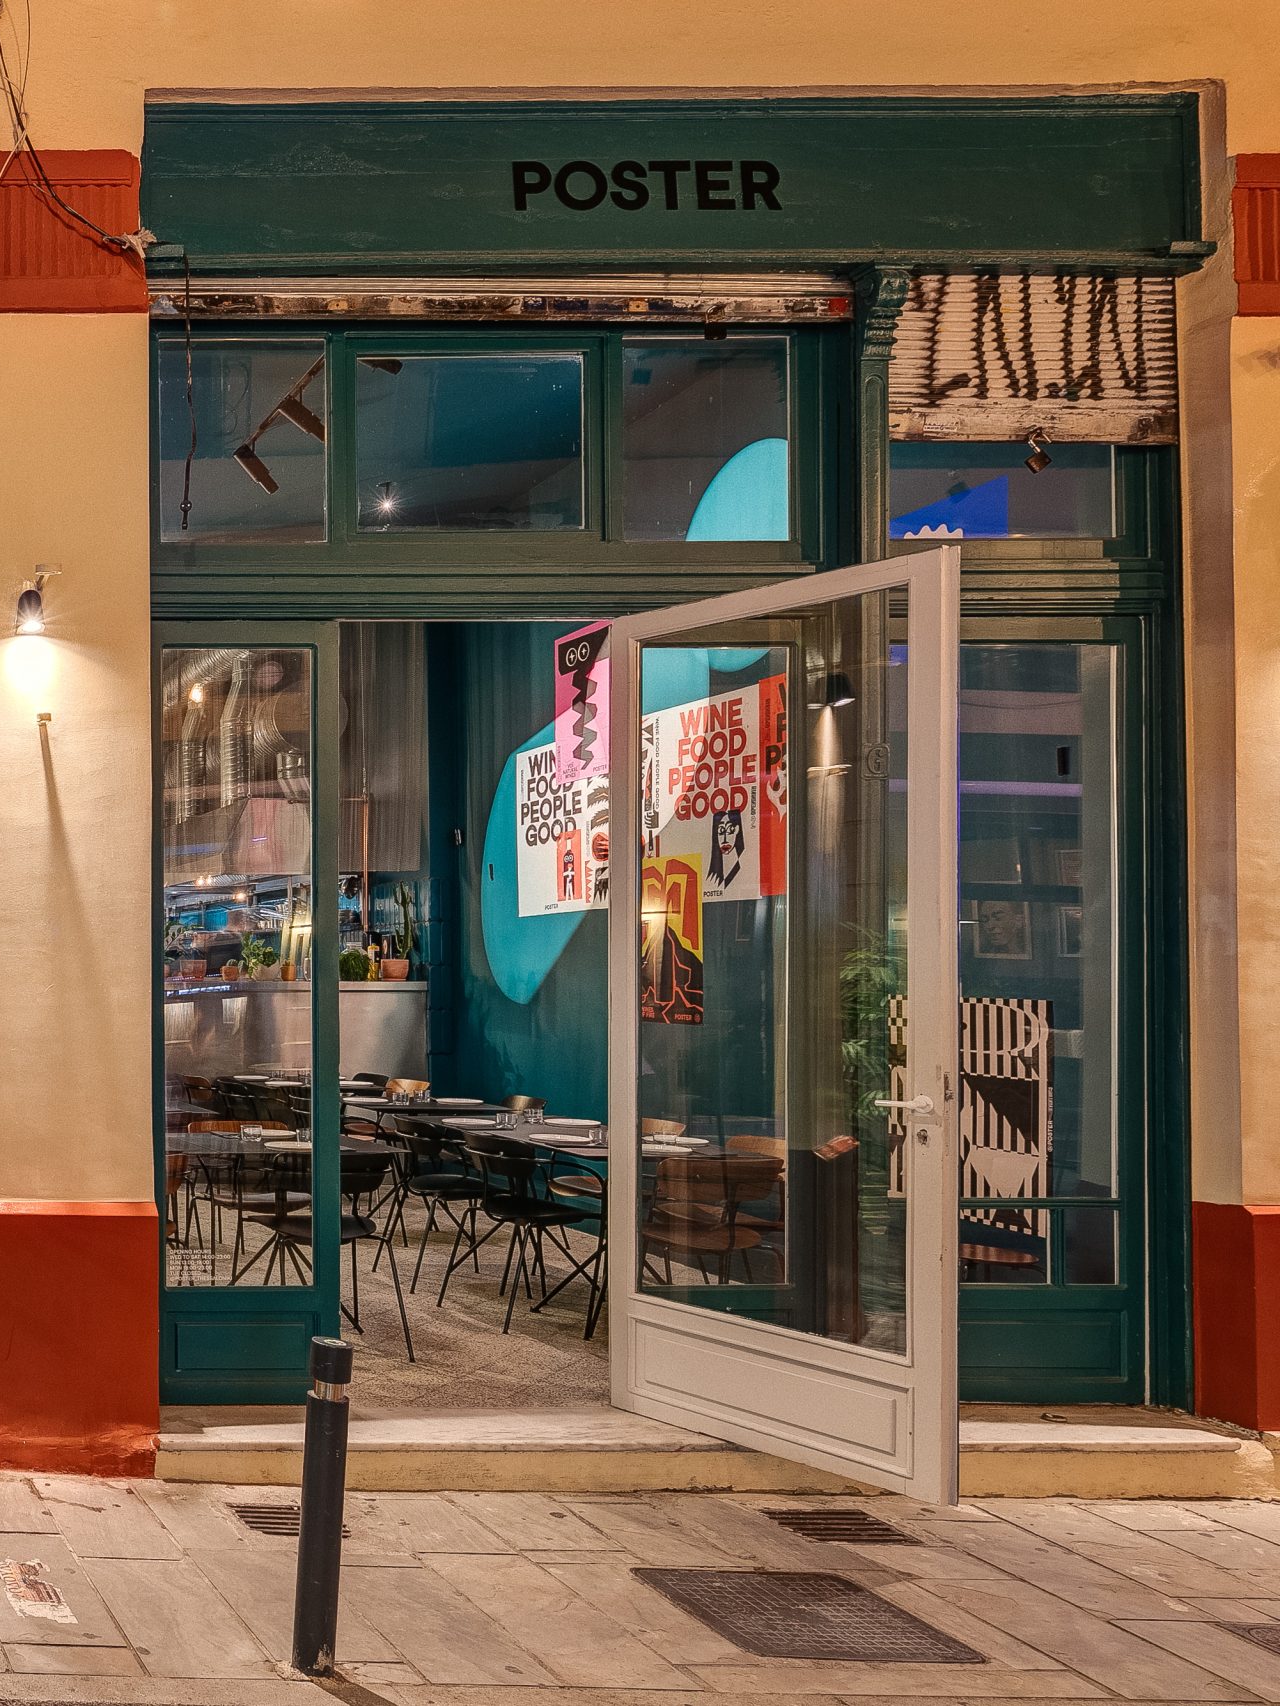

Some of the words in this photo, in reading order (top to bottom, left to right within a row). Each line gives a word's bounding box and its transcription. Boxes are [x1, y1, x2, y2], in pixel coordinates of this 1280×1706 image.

[512, 160, 783, 211] POSTER
[680, 697, 743, 738] WINE
[528, 750, 557, 777] WIN
[677, 727, 747, 767] FOOD
[668, 754, 757, 795] PEOPLE
[521, 790, 582, 825] PEOPLE
[674, 785, 748, 821] GOOD
[525, 816, 577, 847] GOOD
